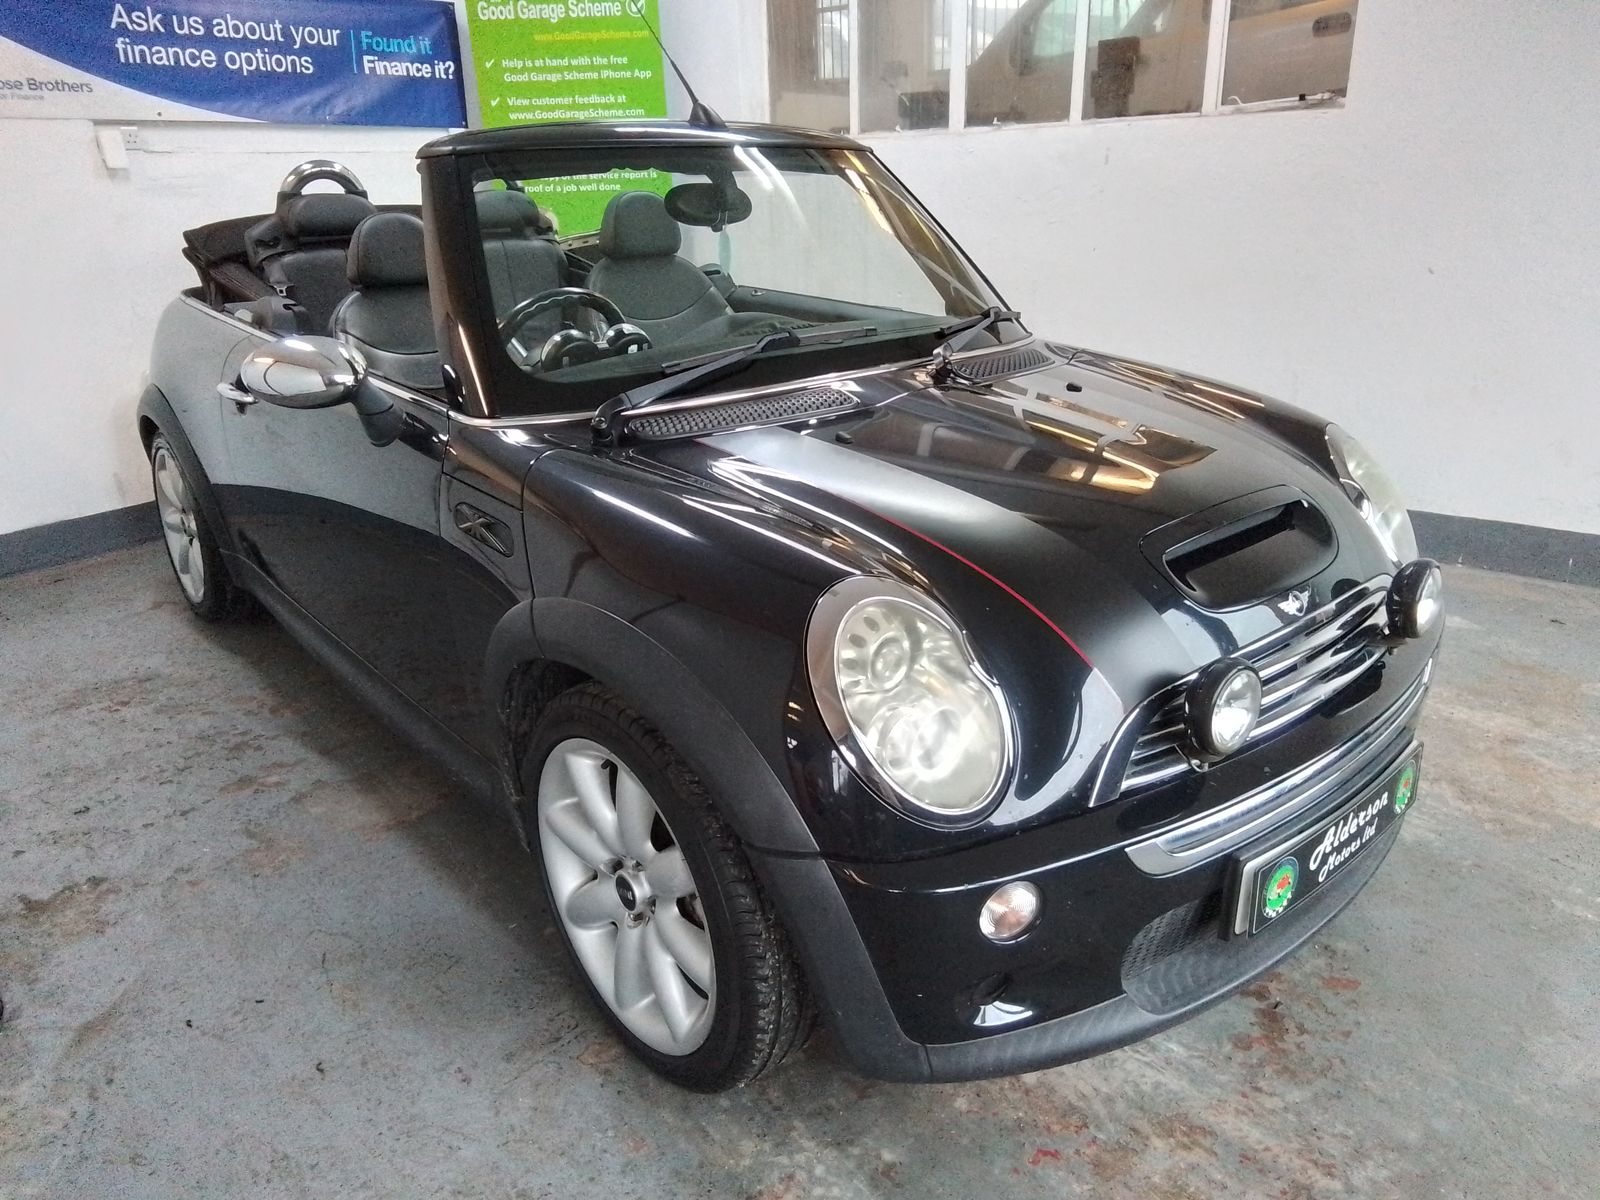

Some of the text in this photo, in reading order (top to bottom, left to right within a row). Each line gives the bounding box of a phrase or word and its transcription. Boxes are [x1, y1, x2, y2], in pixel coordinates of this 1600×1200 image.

[477, 0, 622, 23] Good Garage Scheme
[111, 4, 340, 49] Ask us about your
[360, 31, 433, 55] Found it
[115, 37, 314, 76] finance options
[502, 54, 628, 69] Help is at hand with the free
[362, 55, 456, 80] Finance it?
[504, 69, 652, 82] Good Garage Scheme iPhone App
[26, 77, 94, 93] Brothers
[507, 94, 626, 106] View customer feedback at
[509, 108, 645, 120] www.GoodGarageScheme.com
[589, 171, 619, 180] service
[621, 171, 647, 181] report
[524, 184, 543, 193] roof
[545, 184, 555, 192] of
[563, 183, 578, 194] job
[578, 183, 598, 191] well
[599, 183, 621, 191] done
[1309, 791, 1388, 871] Alderson
[1318, 816, 1379, 883] Motors ltd
